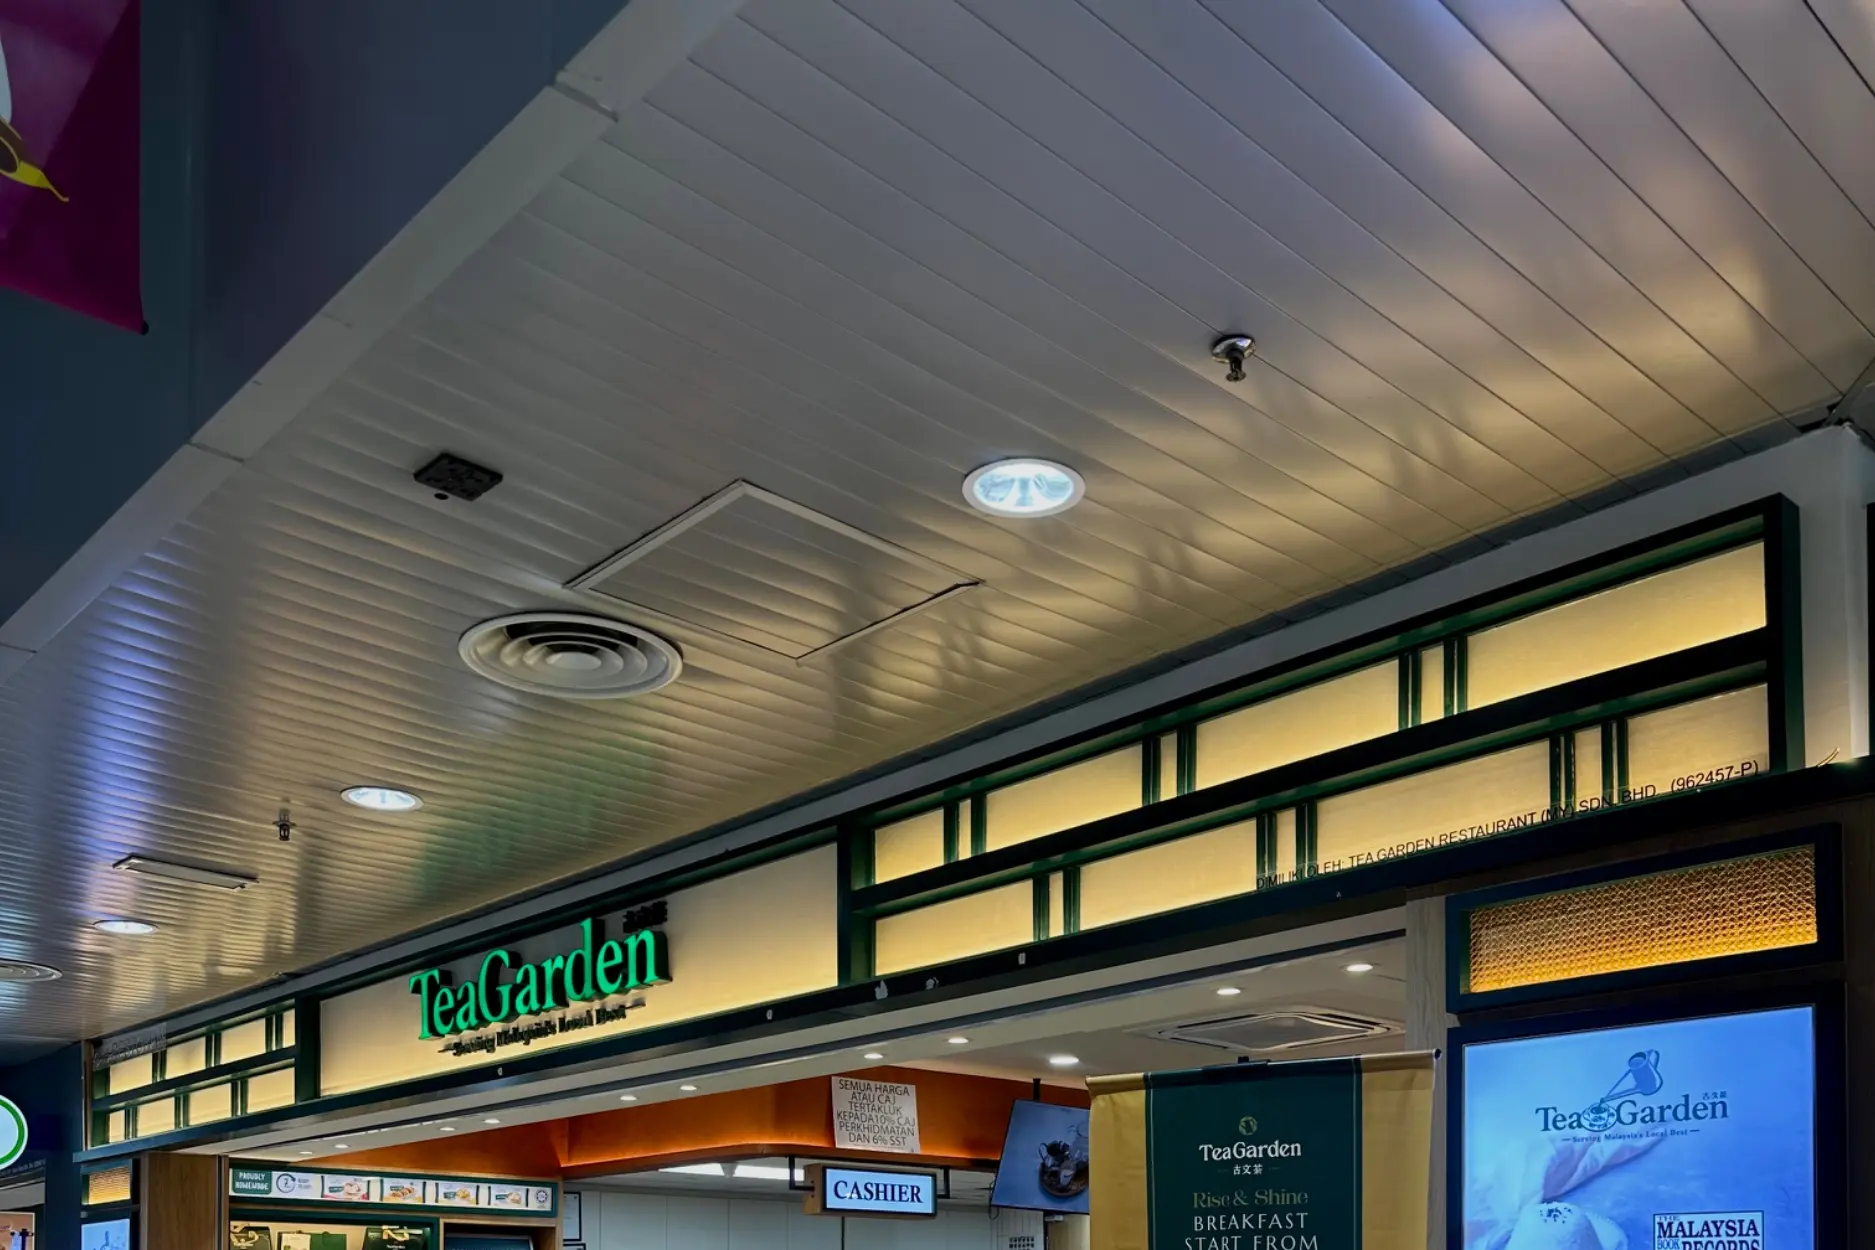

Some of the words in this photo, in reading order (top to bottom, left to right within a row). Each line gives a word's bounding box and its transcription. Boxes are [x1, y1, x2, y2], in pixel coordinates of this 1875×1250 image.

[1256, 867, 1304, 890] DIMILIKI
[1348, 853, 1374, 868] TEA
[1377, 837, 1435, 861] GARDEN
[1439, 811, 1536, 849] RESTAURANT
[1541, 804, 1576, 825] (MY)
[1671, 760, 1759, 793] (962457-P)
[409, 917, 668, 1040] TeaGarden
[839, 1079, 872, 1092] SEMUA
[875, 1083, 910, 1096] HARGA
[851, 1091, 875, 1103] ATAU
[877, 1094, 896, 1105] CAJ
[848, 1101, 902, 1116] TERTAKLUK
[1535, 1106, 1583, 1132] Tea
[1616, 1094, 1729, 1125] Garden
[840, 1121, 915, 1136] PERKHIDMATAN
[897, 1116, 915, 1127] CAJ
[849, 1133, 870, 1144] DAN
[872, 1134, 888, 1145] 6%
[890, 1136, 907, 1146] SST
[1572, 1135, 1600, 1143] Serving
[1604, 1131, 1643, 1141] Malaysia's
[1645, 1129, 1667, 1138] Local
[1671, 1128, 1688, 1136] Best
[1199, 1140, 1302, 1162] TeaGarden
[833, 1180, 923, 1204] CASHIER
[1193, 1191, 1231, 1209] Rise
[1233, 1190, 1249, 1206] &
[1254, 1187, 1308, 1206] Shine
[1194, 1212, 1308, 1232] BREAKFAST
[1657, 1219, 1760, 1239] MALAYSIA
[1657, 1239, 1680, 1250] BOOK
